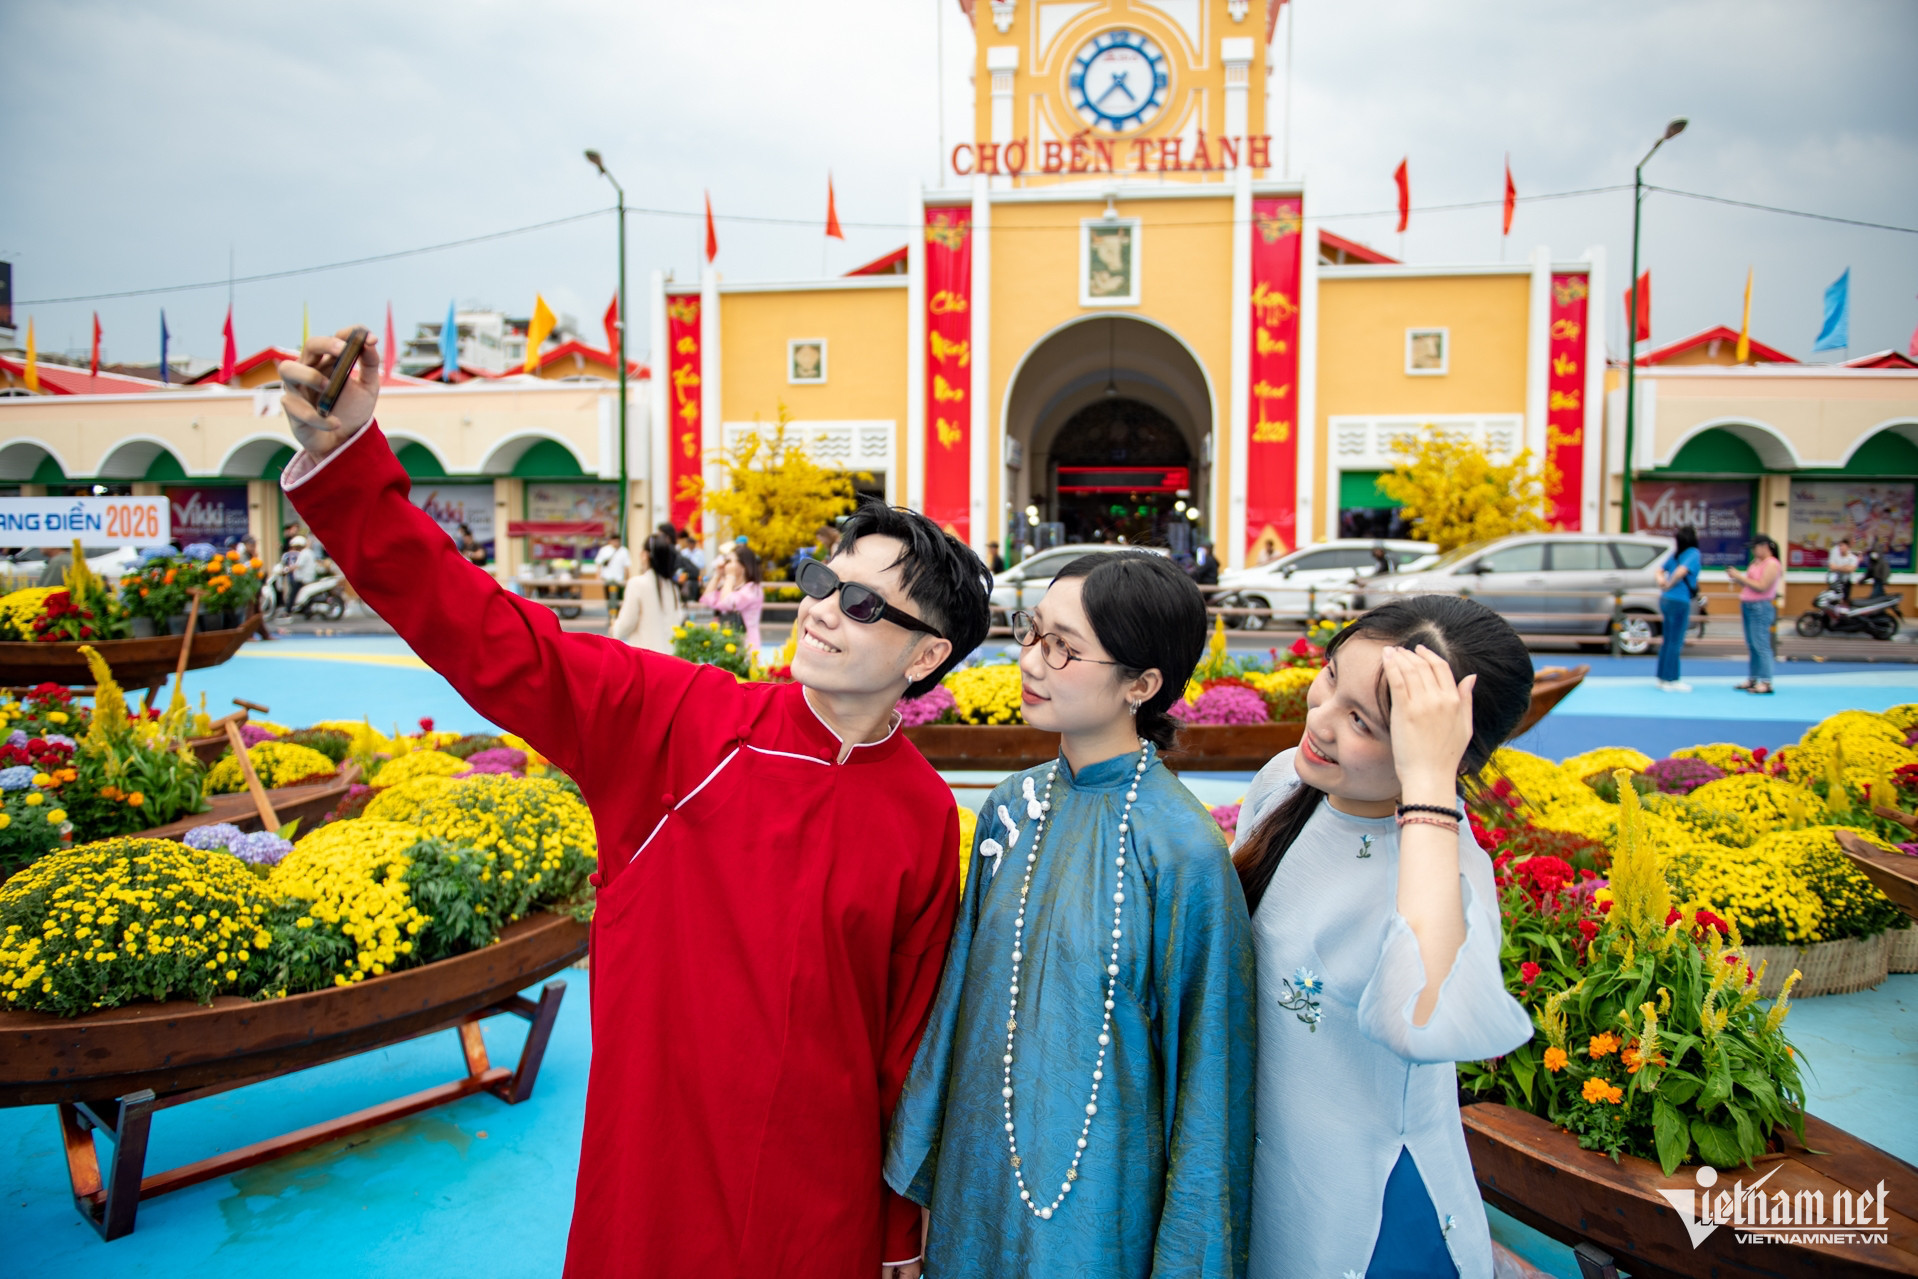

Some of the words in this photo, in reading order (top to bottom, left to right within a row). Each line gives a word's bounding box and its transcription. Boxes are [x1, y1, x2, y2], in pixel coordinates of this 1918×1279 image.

[951, 137, 1029, 177] CHỢ
[1042, 129, 1117, 173] BẾN
[1131, 128, 1272, 172] THÀNH
[44, 501, 102, 531] ĐIỀN
[106, 504, 159, 538] 2026
[1636, 487, 1707, 529] Vikki
